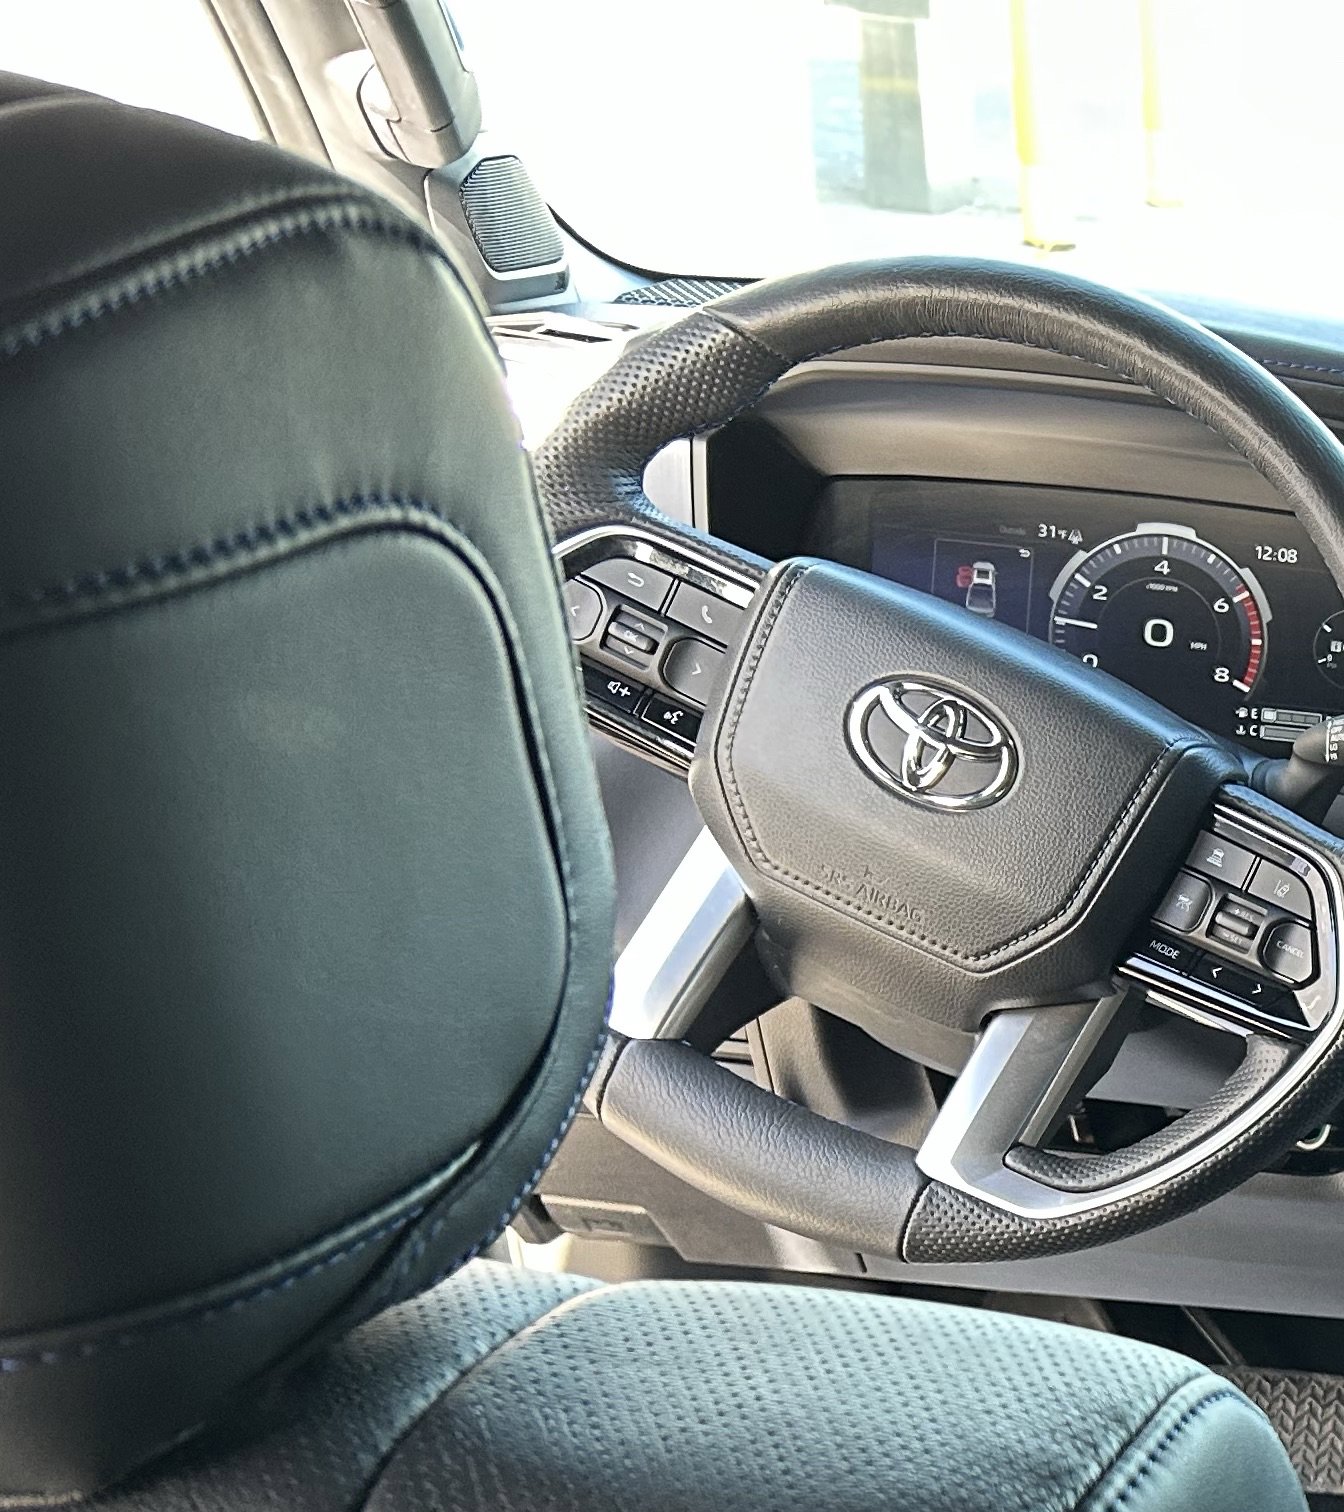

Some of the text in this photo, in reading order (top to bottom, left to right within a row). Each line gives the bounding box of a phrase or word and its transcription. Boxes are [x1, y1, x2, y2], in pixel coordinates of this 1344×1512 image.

[1255, 545, 1298, 564] 12:08
[1153, 560, 1171, 576] 4
[1092, 585, 1109, 601] 2
[1213, 597, 1230, 614] 6
[1143, 618, 1174, 648] 0
[1190, 641, 1208, 651] MPH
[1213, 667, 1230, 682] 8
[1251, 708, 1259, 720] E
[1249, 725, 1258, 737] C
[855, 882, 922, 923] AIRBAG
[1150, 940, 1179, 960] MODE
[1276, 939, 1304, 959] CANCEL
